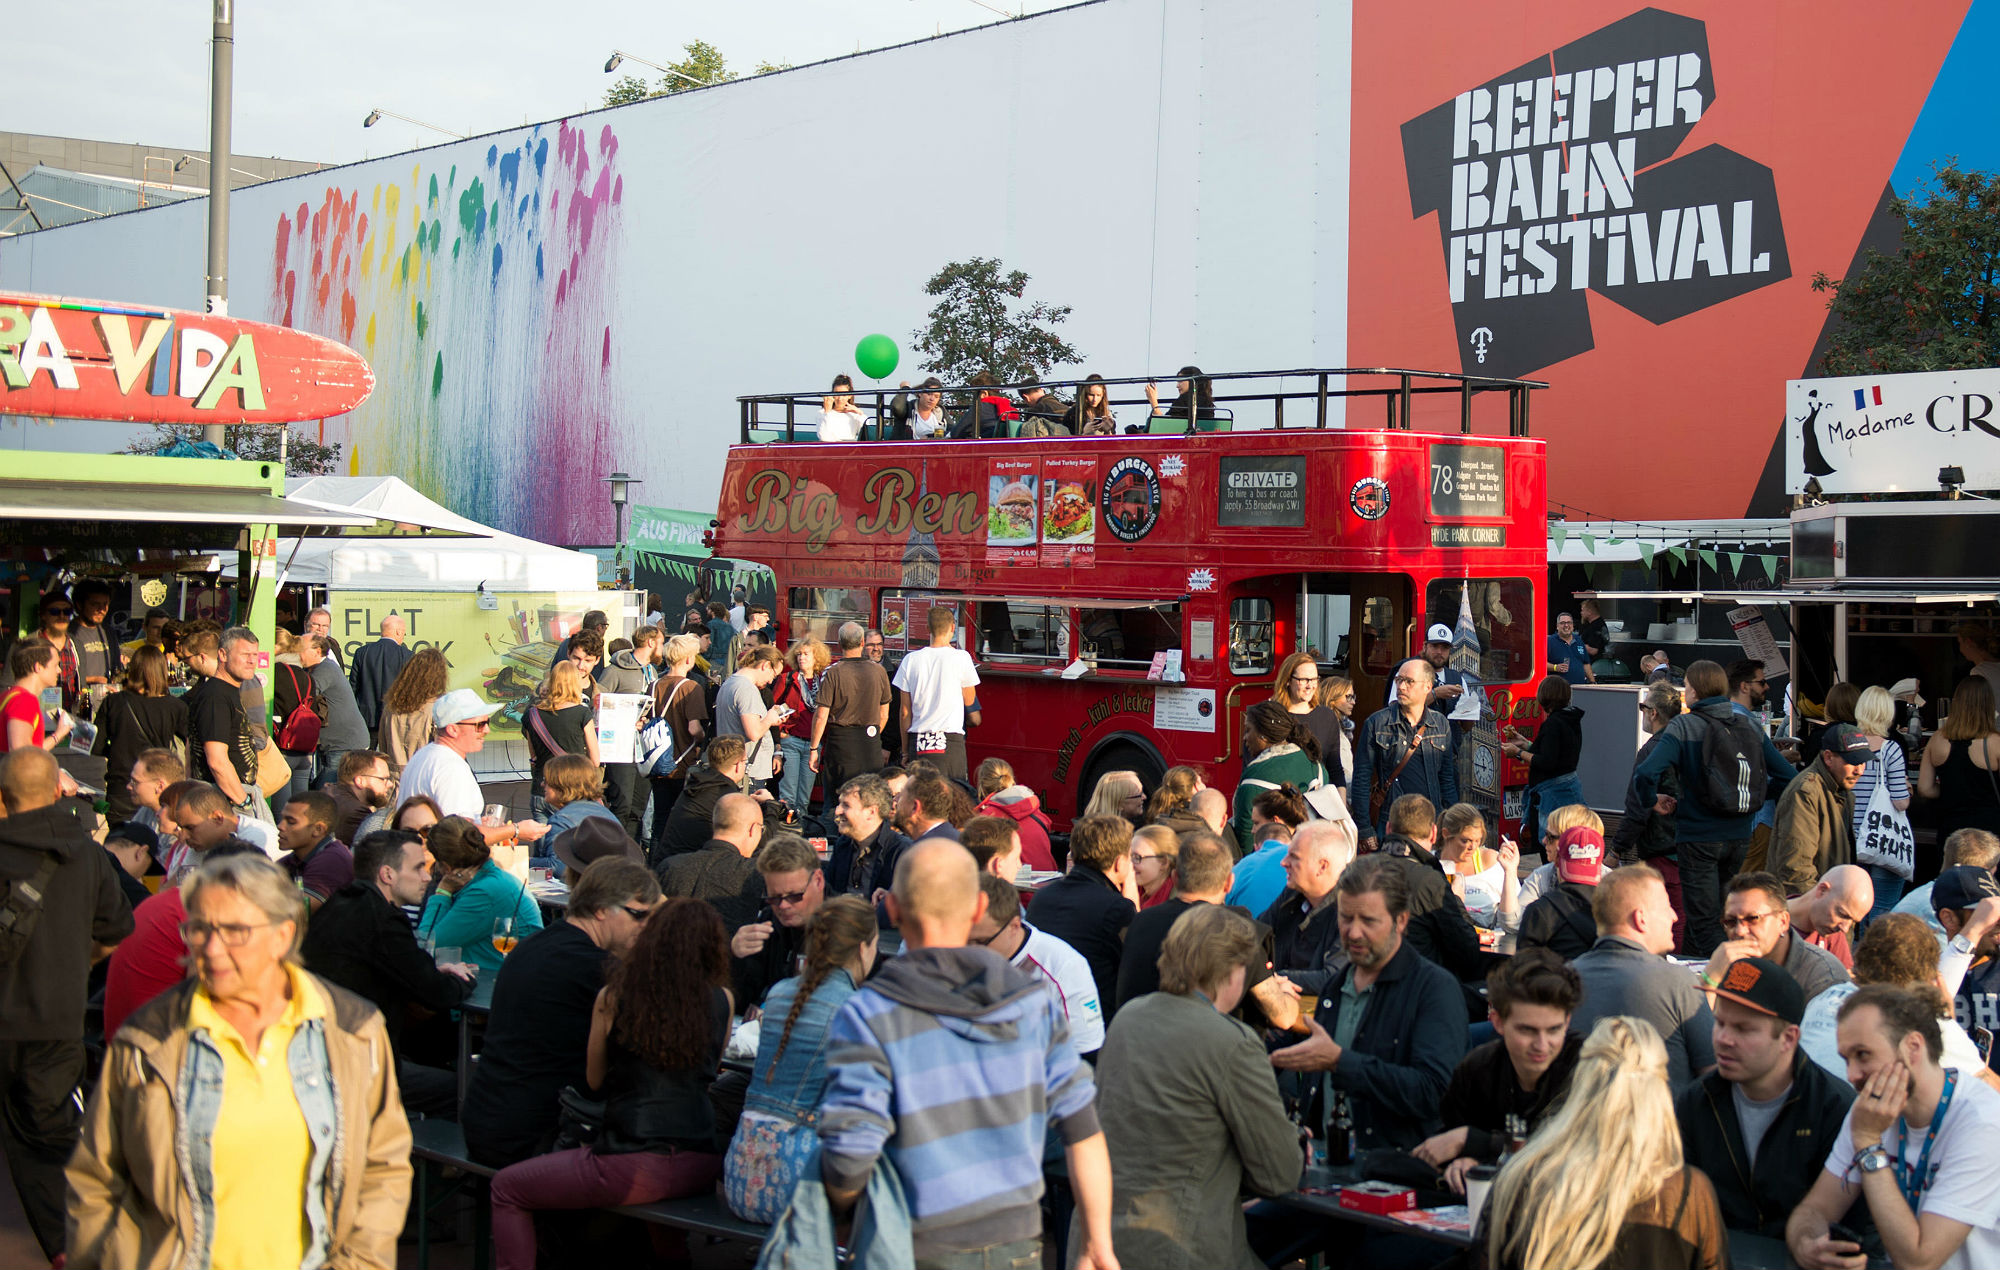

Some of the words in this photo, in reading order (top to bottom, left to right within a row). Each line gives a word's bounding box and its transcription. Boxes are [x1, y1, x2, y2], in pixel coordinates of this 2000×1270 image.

[1453, 52, 1702, 159] REEPER
[1450, 137, 1636, 231] BAHN
[94, 314, 266, 410] VIDA
[1828, 411, 1915, 443] Madame
[1110, 457, 1154, 480] BURGER
[1460, 461, 1479, 470] Liverpool
[1480, 462, 1494, 470] Street
[1475, 471, 1486, 480] Tower
[1233, 472, 1292, 487] PRIVATE
[1431, 464, 1453, 495] 78
[1227, 488, 1233, 498] To
[1236, 488, 1246, 498] hire
[1256, 488, 1267, 498] bus
[1270, 490, 1277, 498] or
[1280, 488, 1298, 498] coach
[1476, 493, 1485, 501] Park
[1486, 494, 1497, 502] Road
[738, 468, 842, 553] Big
[856, 466, 983, 535] Ben
[1253, 500, 1285, 513] Broadway
[637, 519, 669, 541] AUS
[1431, 527, 1449, 542] HYDE
[1452, 527, 1469, 542] PARK
[1472, 528, 1500, 543] CORNER
[843, 563, 896, 578] Cocktails
[954, 564, 996, 583] Burger
[345, 608, 423, 636] FLT
[1087, 697, 1111, 728] kühl
[1112, 693, 1121, 714] &
[1122, 691, 1153, 714] lecker
[1486, 689, 1541, 722] Ben
[916, 739, 947, 752] NZS
[1868, 810, 1912, 841] good
[1865, 833, 1912, 865] stuff
